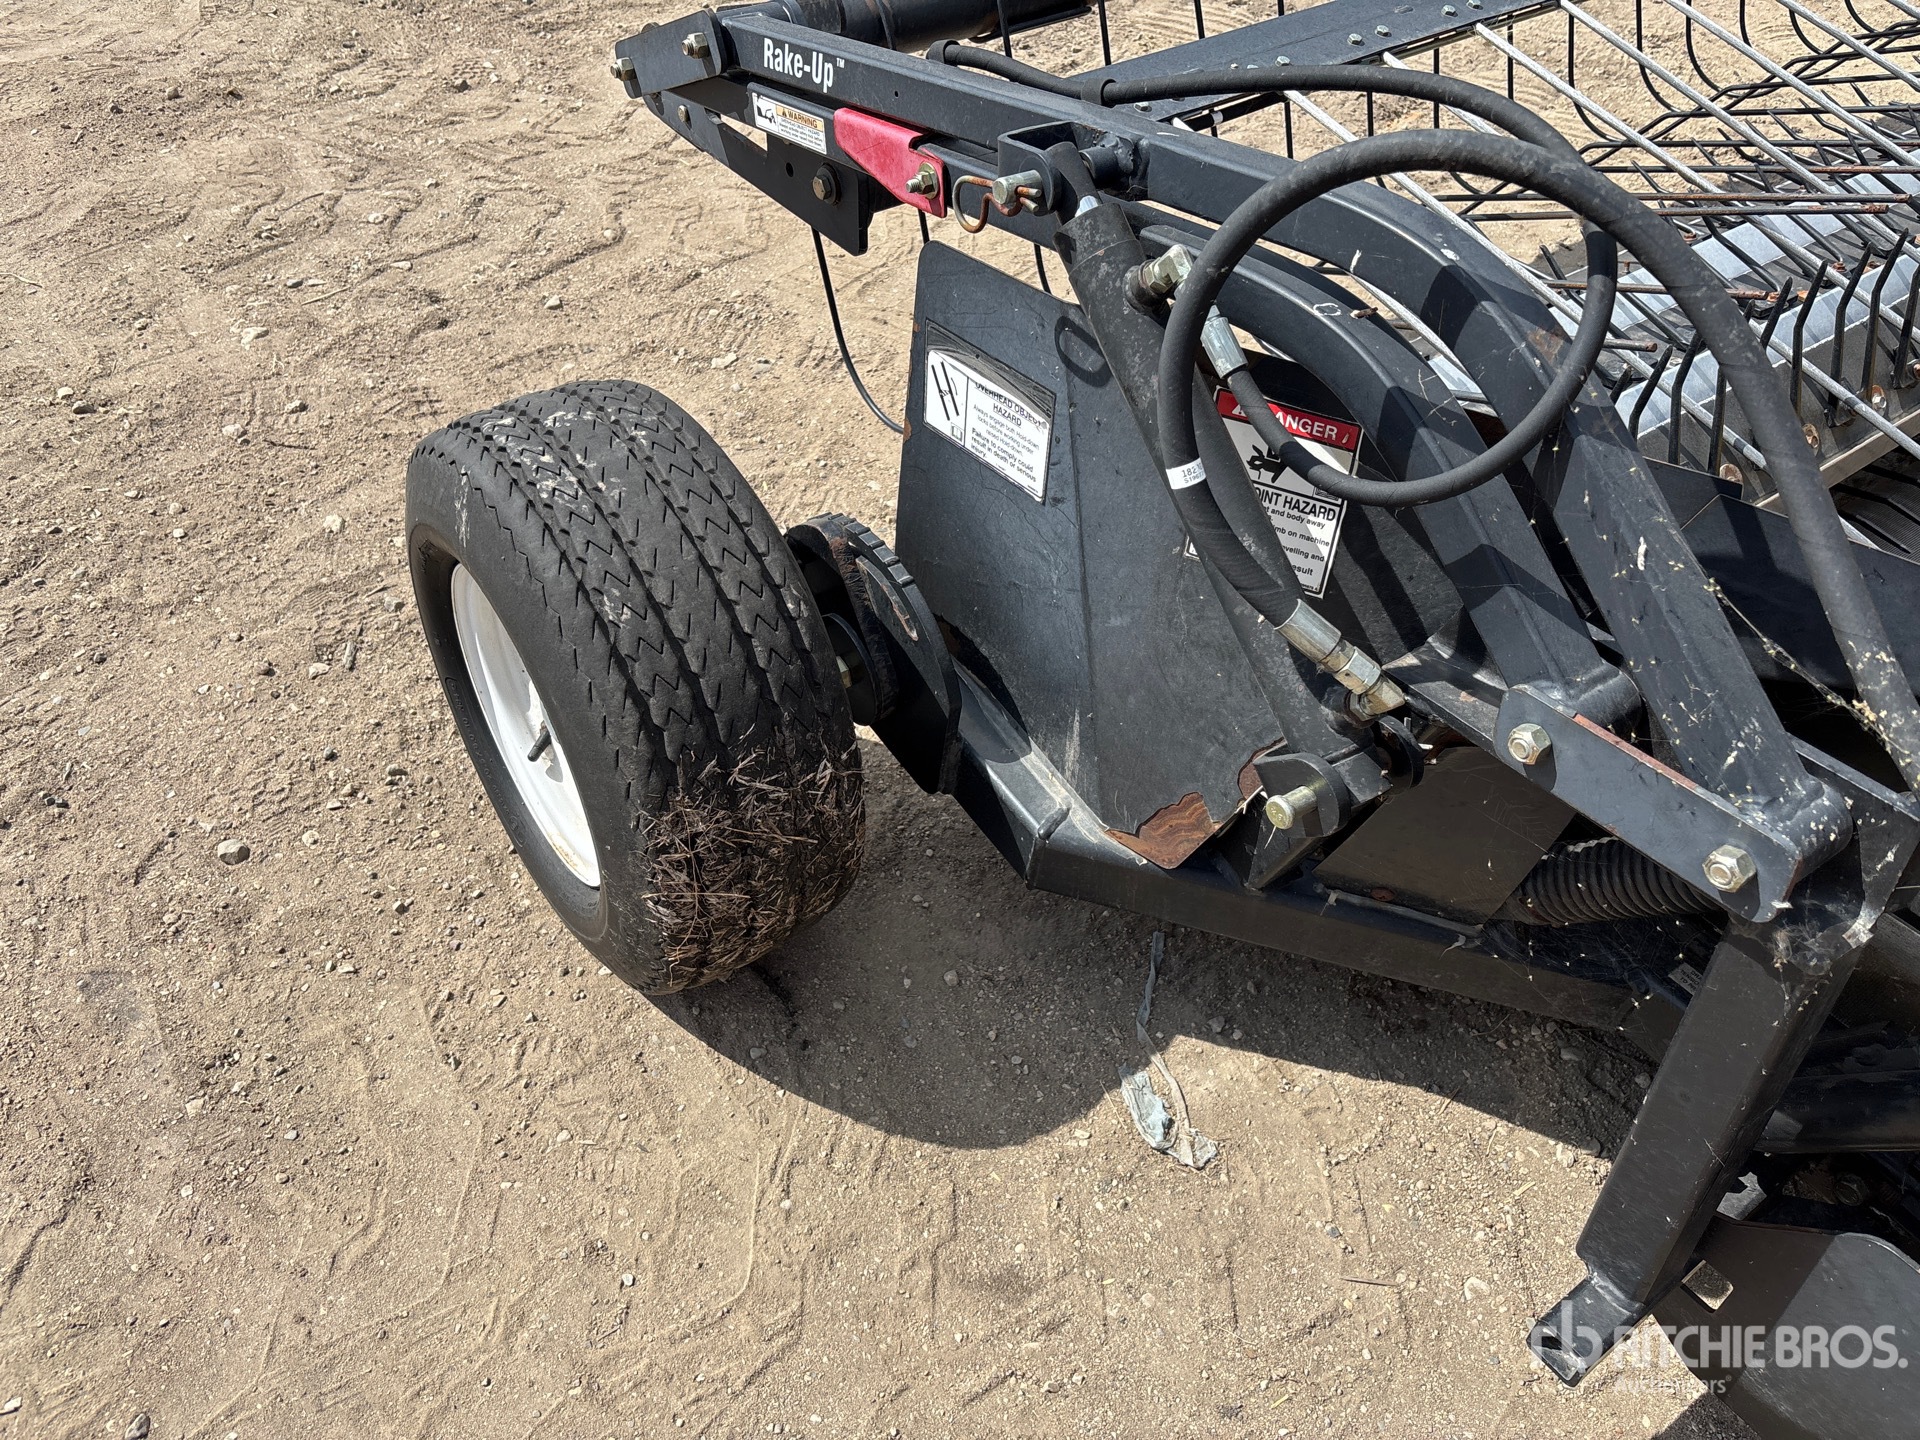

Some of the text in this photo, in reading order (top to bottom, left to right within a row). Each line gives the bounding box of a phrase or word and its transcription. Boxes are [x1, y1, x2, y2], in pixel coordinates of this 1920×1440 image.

[788, 110, 817, 129] WARNING
[993, 402, 1022, 427] HAZARD
[1276, 411, 1338, 440] ANGER
[972, 426, 990, 444] Failure
[991, 439, 996, 448] to
[997, 443, 1017, 463] comply
[1018, 457, 1034, 473] could
[972, 435, 987, 449] result
[987, 445, 992, 453] in
[993, 449, 1009, 464] death
[1010, 460, 1016, 469] or
[1017, 465, 1037, 483] serious
[1255, 487, 1336, 522] INT HAZARD
[1271, 508, 1285, 517] and
[1286, 511, 1305, 523] body
[1306, 519, 1325, 530] away
[1298, 533, 1330, 547] machine
[1282, 545, 1325, 562] velling and
[1292, 564, 1313, 576] esult
